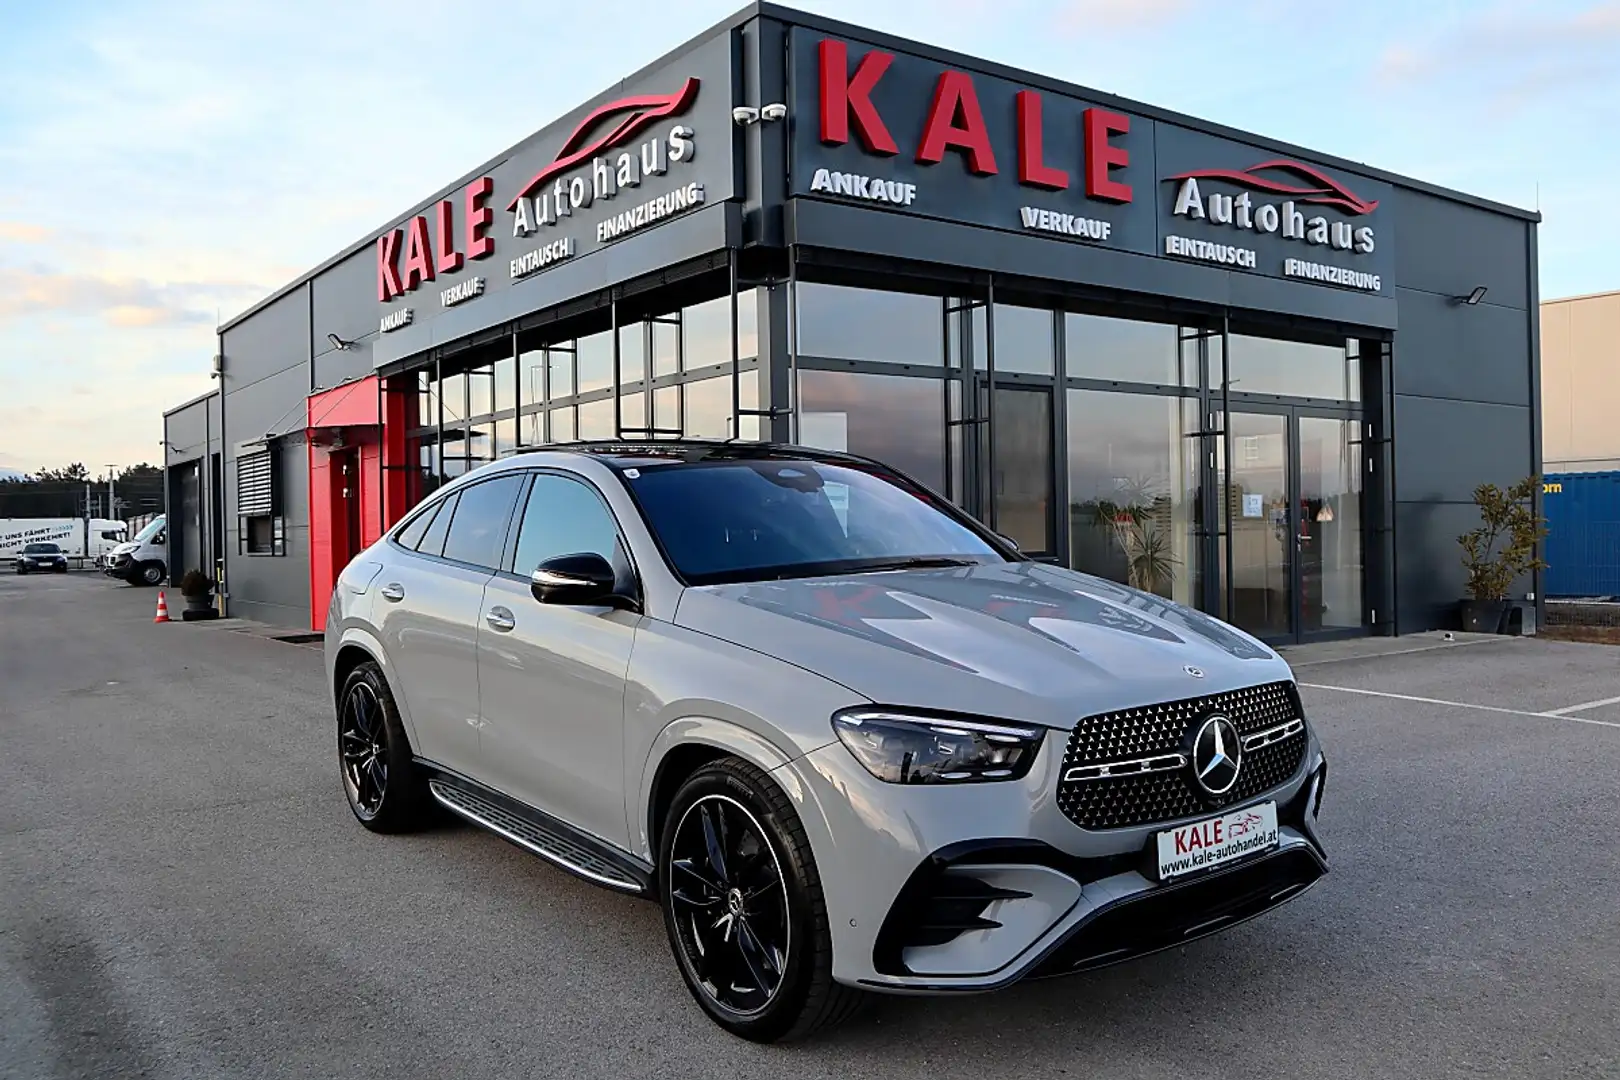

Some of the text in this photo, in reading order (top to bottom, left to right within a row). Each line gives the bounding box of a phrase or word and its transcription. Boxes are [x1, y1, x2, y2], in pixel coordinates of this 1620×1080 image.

[819, 37, 1133, 203] KALE
[511, 124, 695, 237] Autohaus
[810, 168, 917, 206] ANKAUF
[596, 182, 705, 243] FINANZIERUNG
[1020, 206, 1112, 240] VERKAUF
[1173, 177, 1376, 253] Autohaus
[376, 176, 495, 302] KALE
[509, 236, 576, 279] EINTAUSCH
[1165, 235, 1257, 268] EINTAUSCH
[440, 276, 486, 307] VERKAUF
[1284, 257, 1382, 292] FINANZIERUNG
[379, 307, 414, 334] ANKAUF
[1161, 829, 1277, 874] www.kale-autohandel.at
[1174, 820, 1224, 856] KALE
